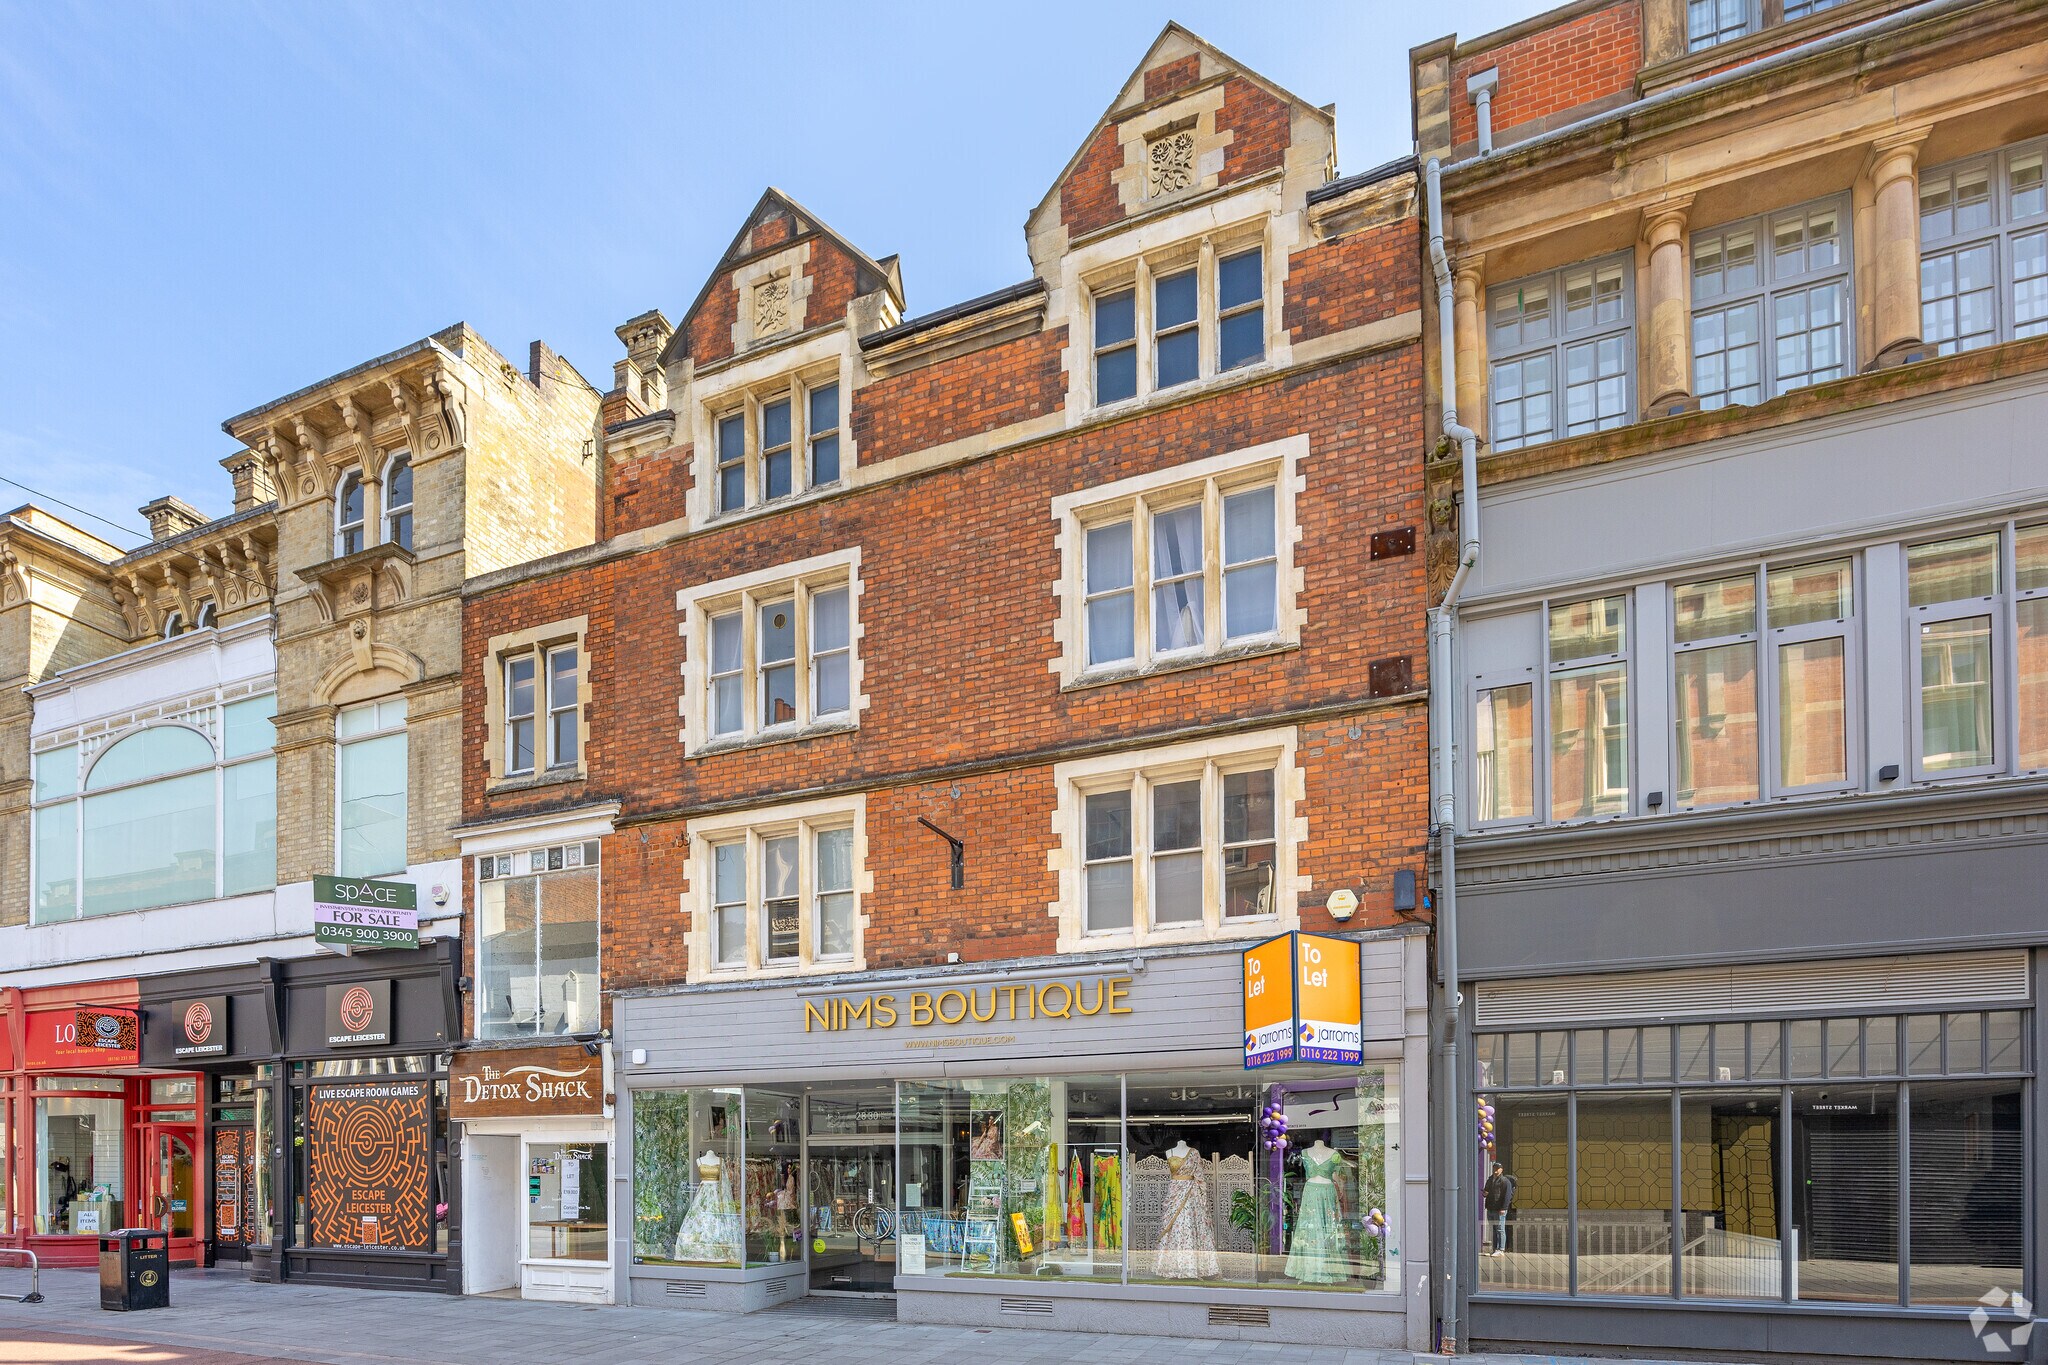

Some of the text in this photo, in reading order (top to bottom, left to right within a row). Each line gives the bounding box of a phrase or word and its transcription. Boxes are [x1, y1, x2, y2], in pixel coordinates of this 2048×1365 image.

[333, 910, 400, 927] FOR SALE
[380, 909, 412, 917] OPPORTUNITY
[321, 926, 413, 942] 0345 900 3900
[1302, 942, 1321, 964] To
[1247, 957, 1261, 977] To
[1303, 966, 1328, 987] Let
[1248, 975, 1265, 998] Let
[805, 976, 1133, 1032] NIMS BOUTIQUE
[329, 1033, 386, 1043] ESCAPE LEICESTER
[905, 1035, 1015, 1048] WWW.NIMSBOUTIQUE.COM
[1258, 1026, 1292, 1049] jarroms
[1317, 1026, 1359, 1044] jarroms
[195, 1045, 223, 1053] LEICESTER
[1301, 1048, 1359, 1062] 0116 222 1999
[1246, 1048, 1293, 1067] 0116 222 1999
[319, 1086, 419, 1099] LIVE ESCAPE ROOM GAMES
[352, 1189, 386, 1200] ESCAPE
[346, 1203, 392, 1214] LEICESTER
